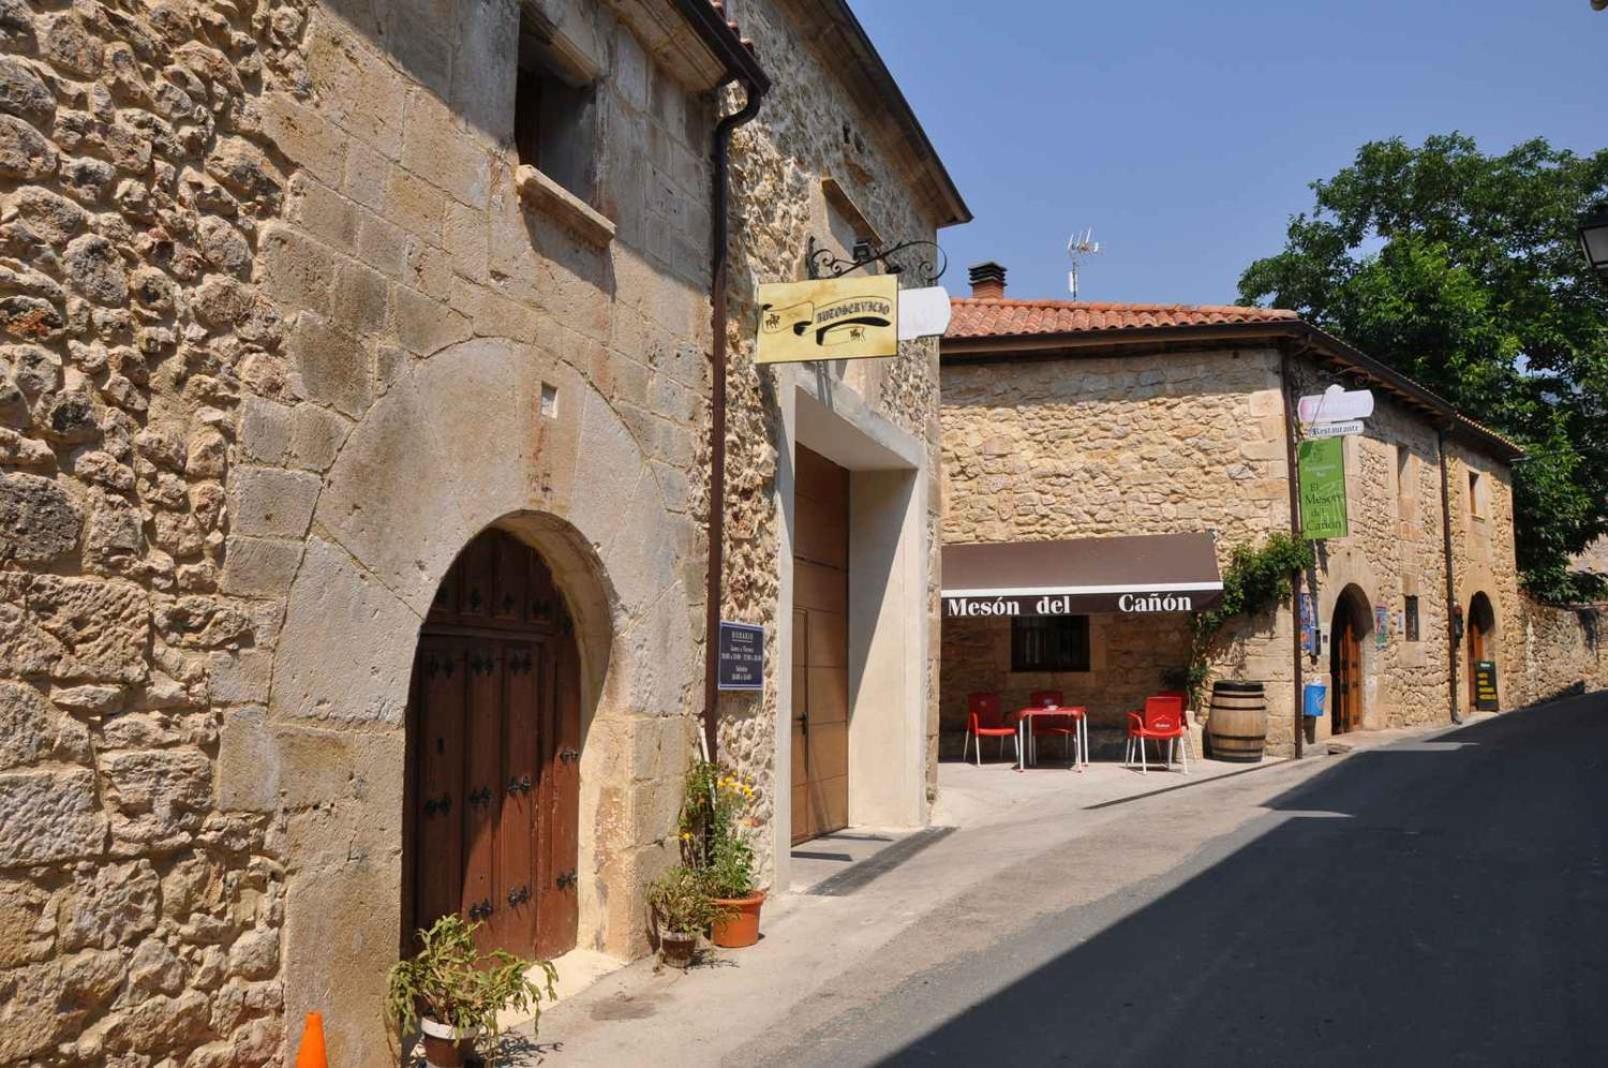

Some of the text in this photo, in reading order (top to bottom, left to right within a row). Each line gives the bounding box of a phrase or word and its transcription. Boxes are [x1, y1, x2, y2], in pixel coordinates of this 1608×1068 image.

[947, 593, 1192, 617] Mesón del Cañón
